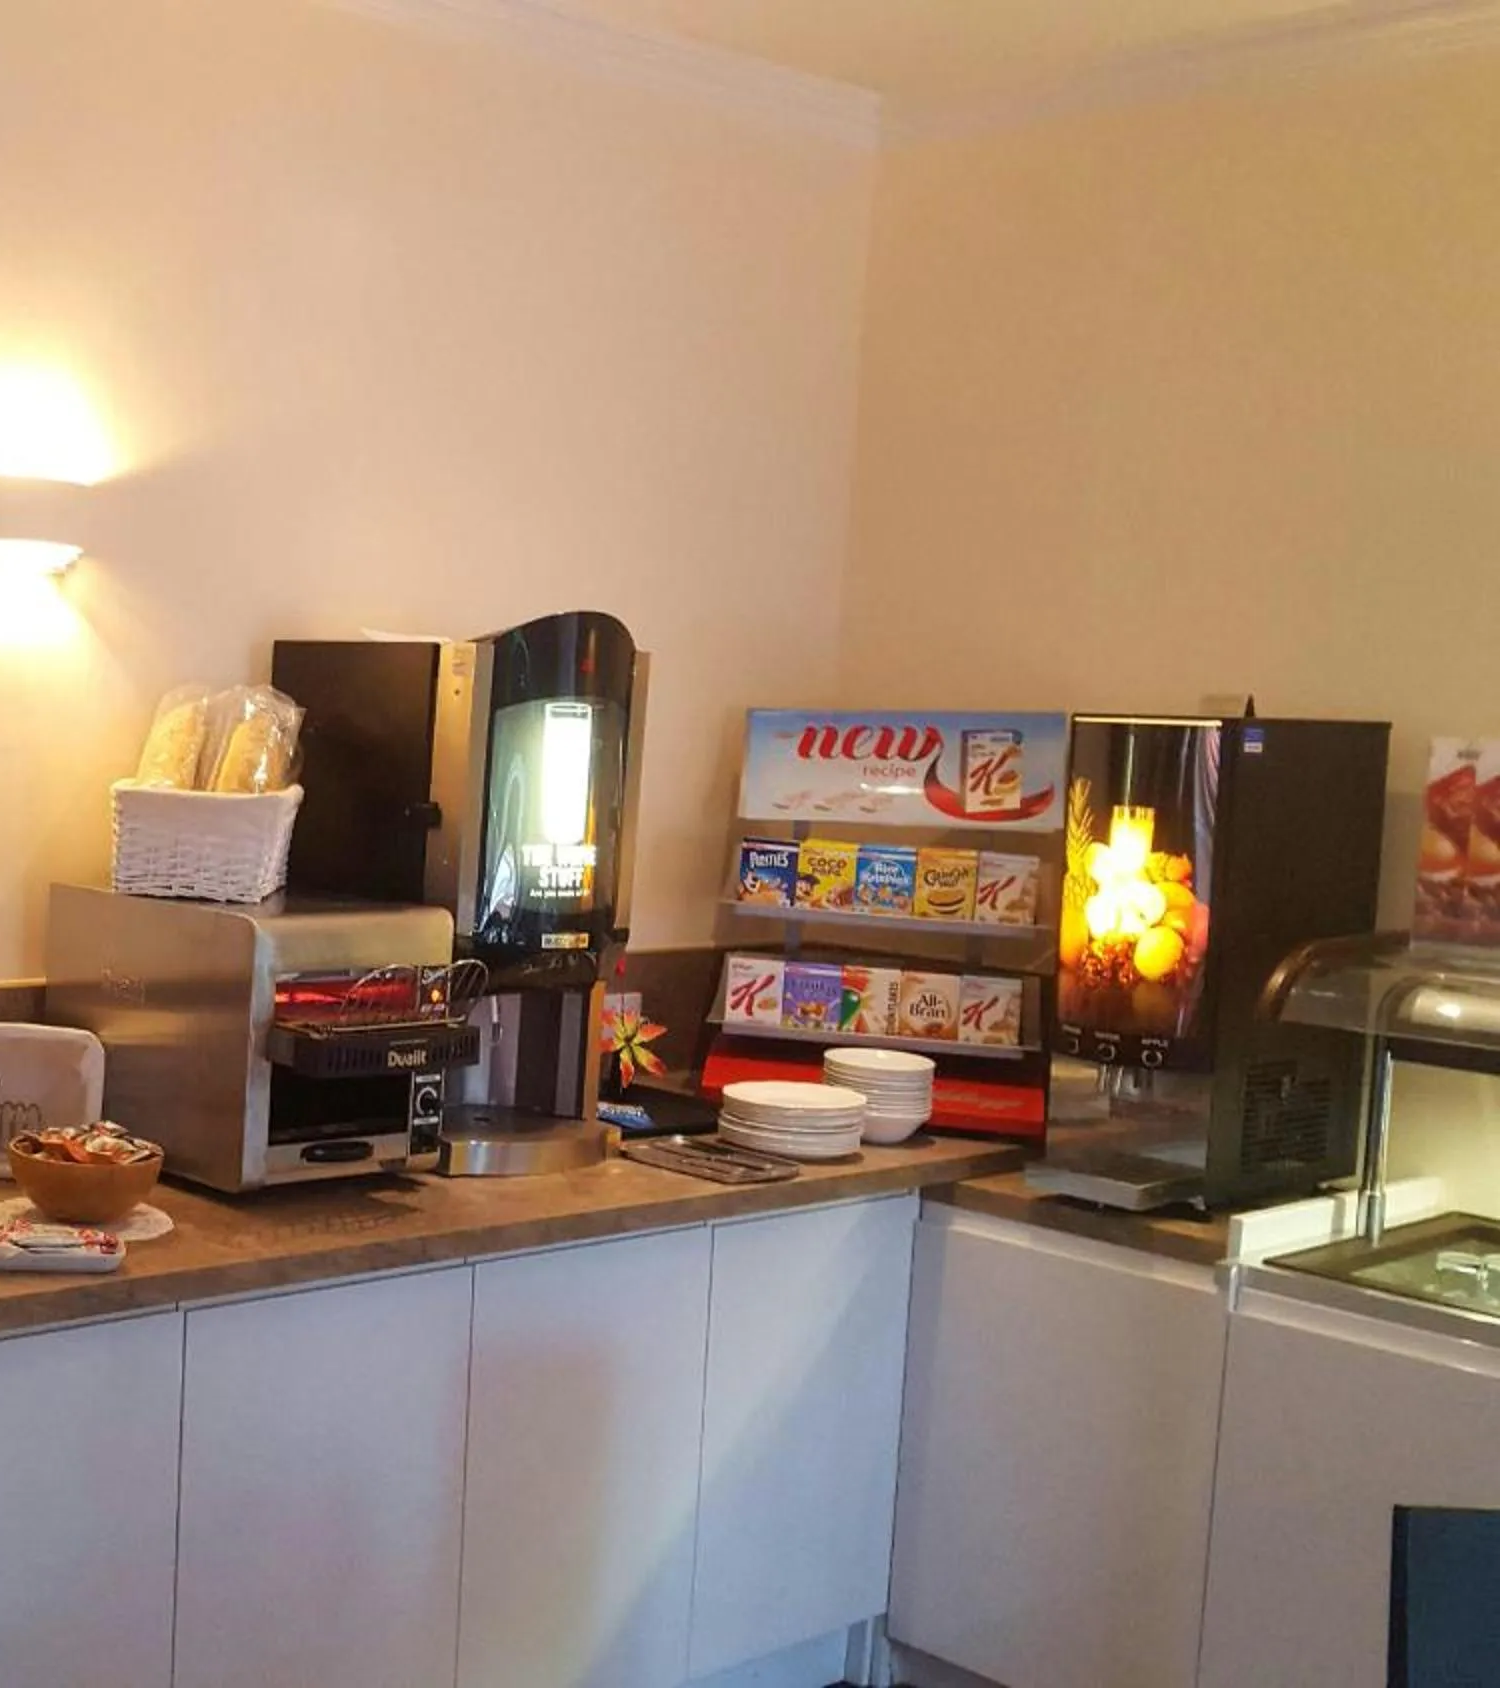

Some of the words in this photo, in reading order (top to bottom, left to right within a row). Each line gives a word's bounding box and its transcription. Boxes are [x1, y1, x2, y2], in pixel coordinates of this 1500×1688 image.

[797, 725, 943, 761] new
[863, 763, 916, 779] recipe
[808, 857, 848, 869] COCO
[978, 875, 1016, 910] K
[730, 974, 775, 1017] K
[909, 1004, 946, 1018] Bran
[962, 995, 999, 1031] K
[387, 1049, 427, 1067] Dualit
